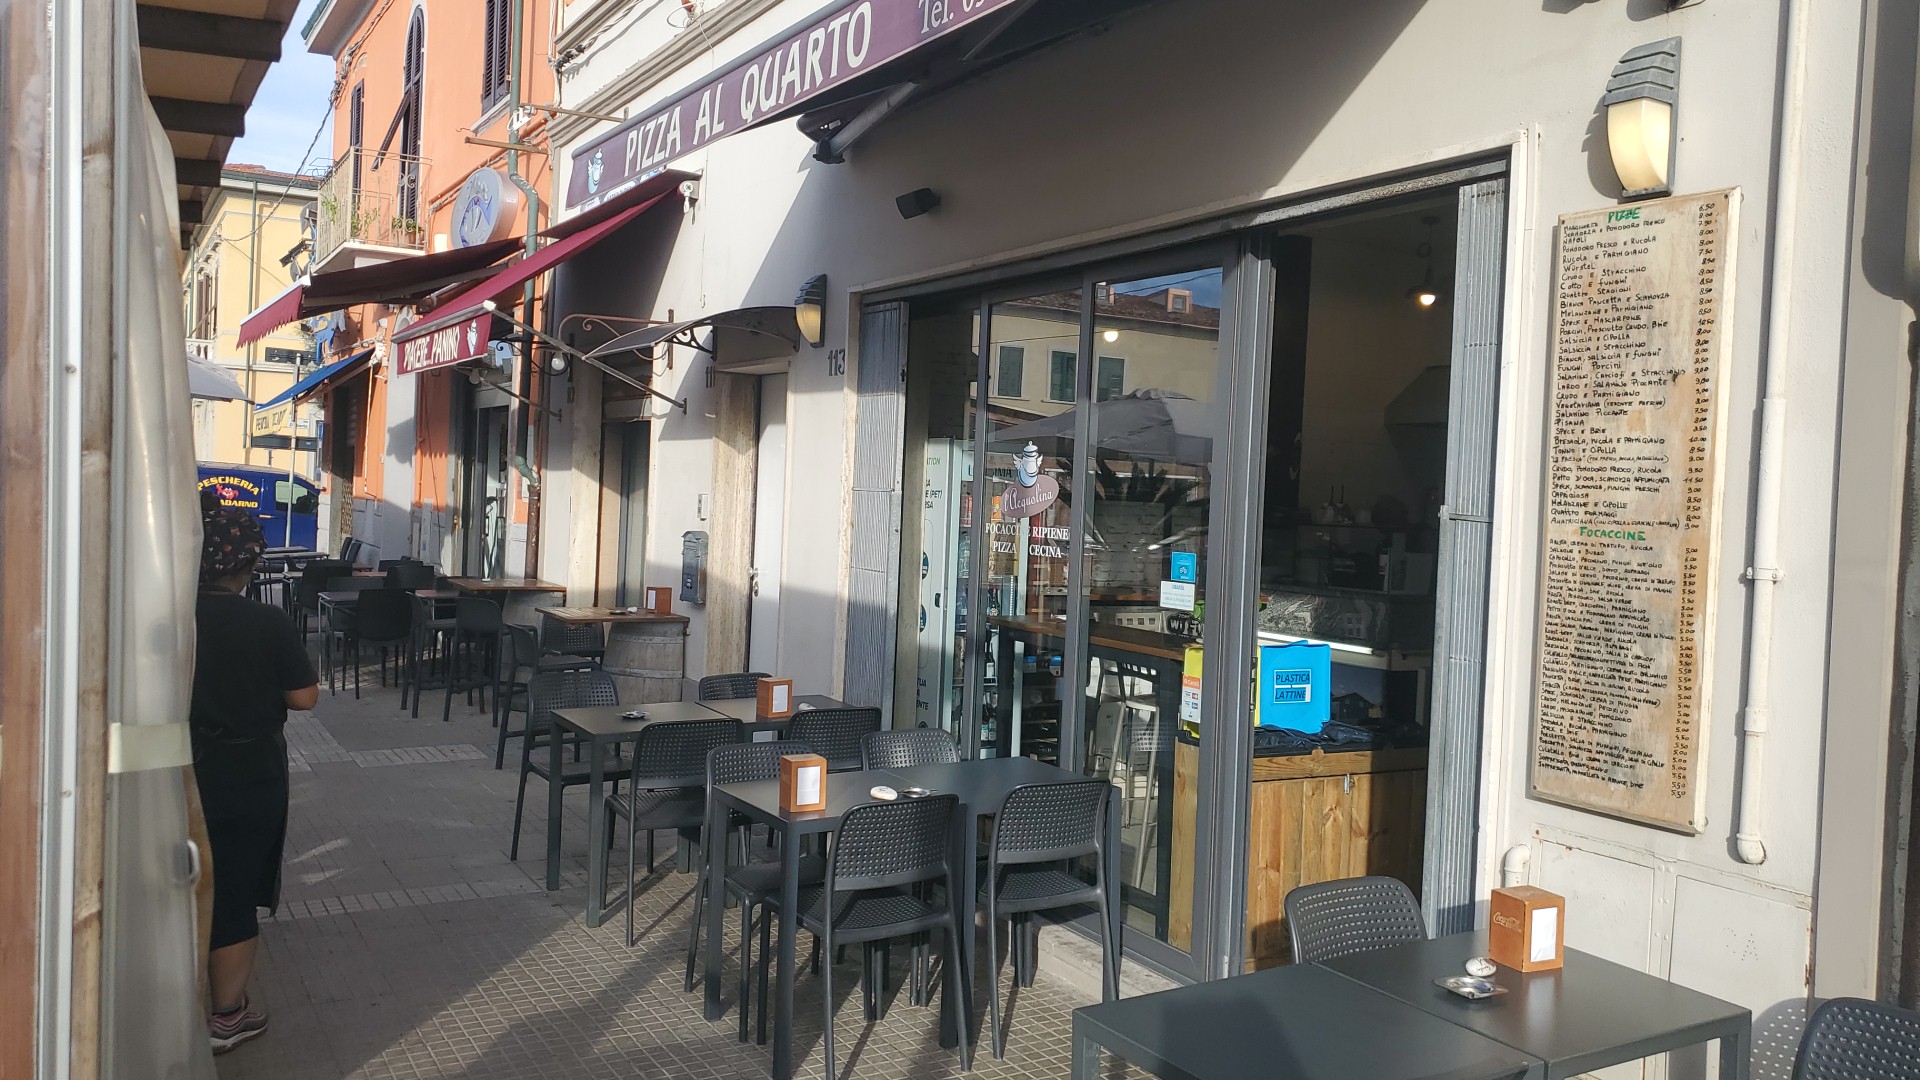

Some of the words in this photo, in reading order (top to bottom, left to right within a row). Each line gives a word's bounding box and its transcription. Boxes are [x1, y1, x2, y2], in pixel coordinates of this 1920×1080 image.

[918, 0, 954, 34] Tel.
[624, 105, 682, 177] PIZZA
[693, 82, 725, 146] AL
[740, 1, 872, 125] QUARTO
[1608, 207, 1642, 223] PIZZE
[1606, 223, 1640, 233] POMODORO
[1562, 236, 1587, 245] NAPOLI
[1562, 245, 1595, 253] POMODORO
[1597, 241, 1618, 249] FRESCO
[1631, 235, 1657, 245] RUCOLA
[1562, 254, 1588, 264] RUCOLA
[1602, 247, 1649, 259] PARMIGIANO
[1602, 265, 1647, 277] STRACCHINO
[1560, 301, 1584, 309] BIANCA
[1588, 296, 1622, 305] PANCETTA
[1635, 292, 1670, 301] SCAMORZA
[1611, 304, 1654, 313] PARMIGIANO
[1593, 314, 1642, 324] MASCARPONE
[1603, 333, 1631, 342] CIPOLLA
[431, 325, 460, 365] PANINO
[1603, 341, 1647, 350] STRACCHINO
[827, 348, 846, 377] 113
[1556, 364, 1583, 372] FUNGHI
[1591, 360, 1622, 370] PORCINI
[1595, 370, 1625, 379] CARCIOFI
[1557, 381, 1580, 390] LARDO
[1556, 391, 1578, 399] CRUDO
[1592, 389, 1640, 398] PARMIGIANO
[1554, 418, 1585, 427] PISANA
[1555, 427, 1576, 435] SPECK
[1589, 426, 1607, 435] BRIE
[1552, 446, 1576, 455] TONNO
[1590, 445, 1617, 454] CIPOLLA
[1638, 466, 1662, 474] RUCOLA
[197, 476, 260, 496] PESCHERIA
[1602, 501, 1628, 509] CIPOLLE
[985, 522, 1031, 537] FOCACCIE
[1032, 526, 1069, 540] RIPIENE
[1579, 526, 1646, 541] FOCACCINE
[992, 540, 1017, 554] PIZZA
[1029, 544, 1062, 558] CECINA
[1276, 673, 1310, 683] PLASTICA
[1275, 690, 1306, 700] LATTINE
